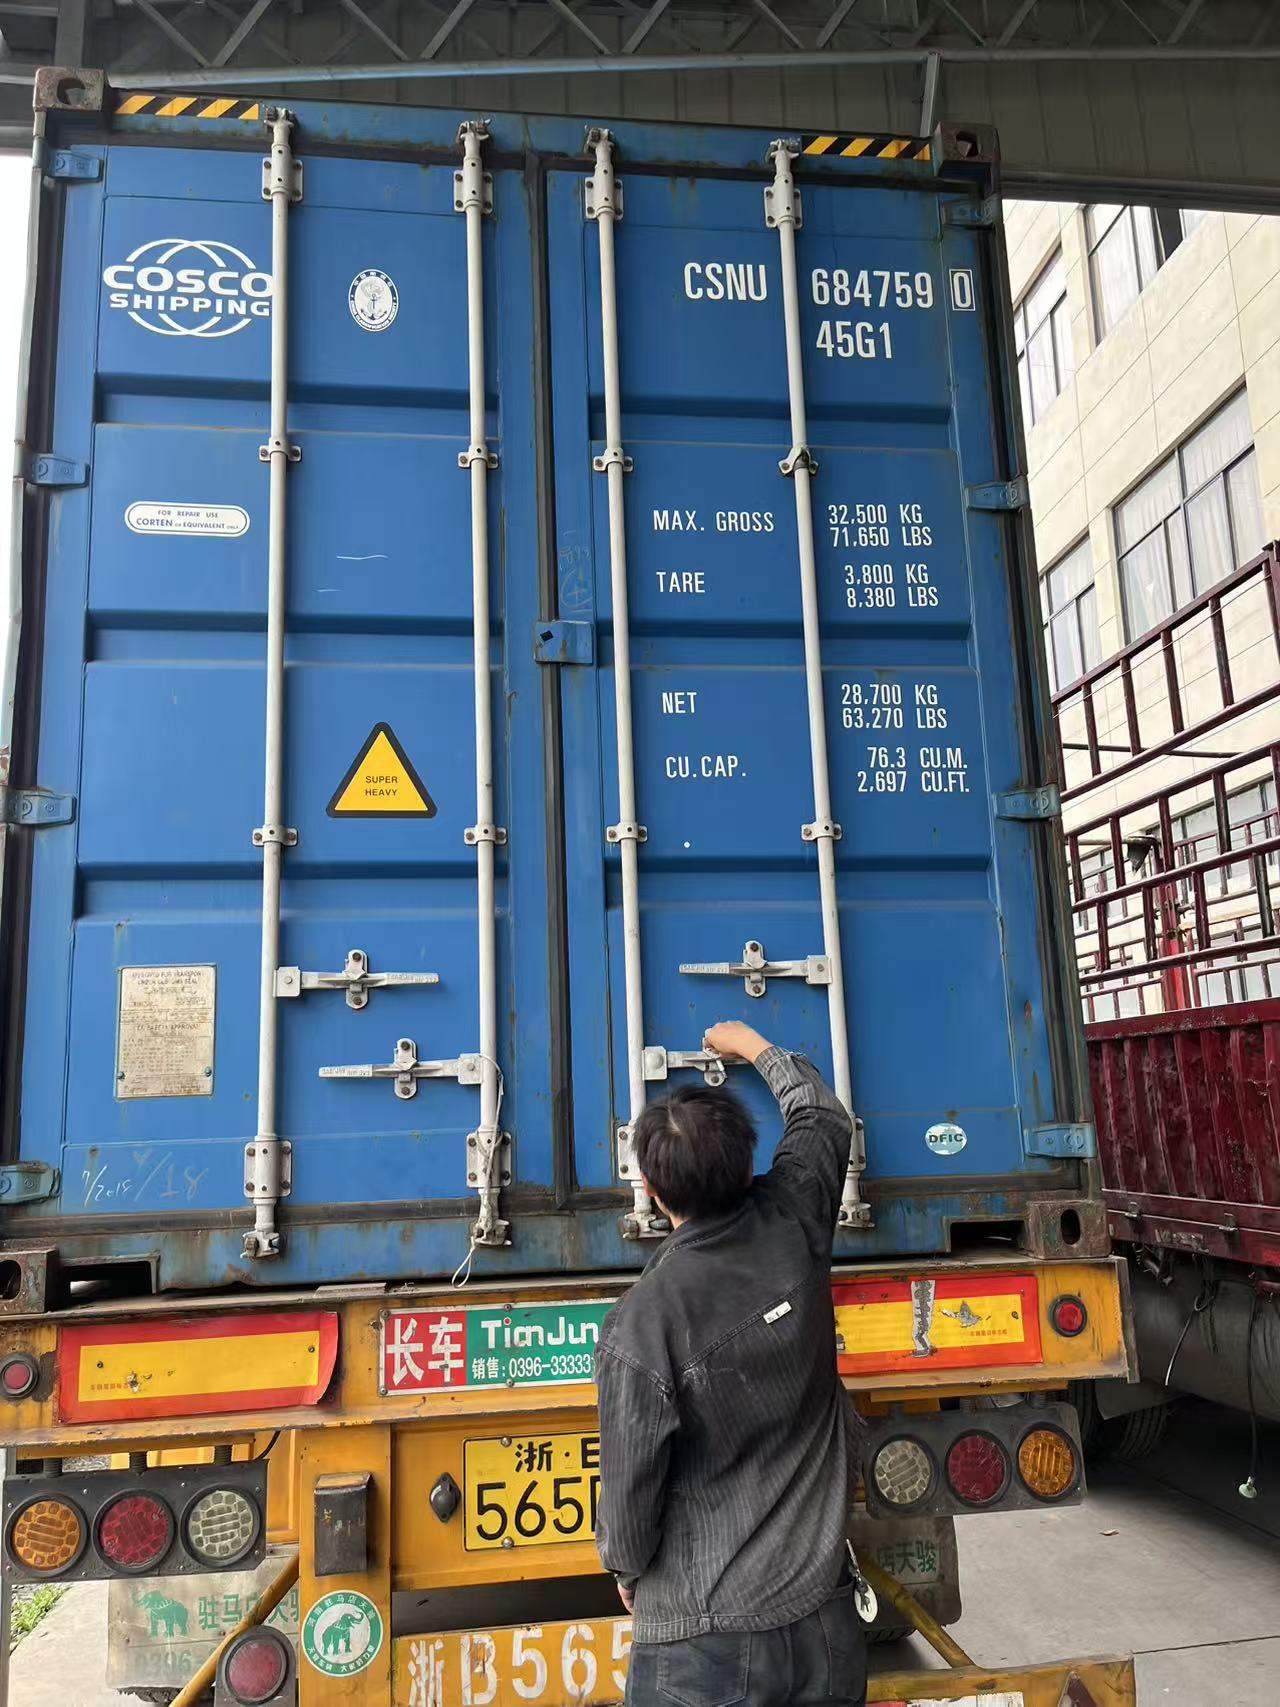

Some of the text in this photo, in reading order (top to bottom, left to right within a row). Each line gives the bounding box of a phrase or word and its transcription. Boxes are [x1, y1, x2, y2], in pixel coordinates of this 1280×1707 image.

[103, 265, 273, 298] COSCO
[684, 262, 972, 308] CSNU 684759 0
[109, 293, 270, 316] SHIPPING
[816, 320, 892, 359] 45G1
[136, 517, 173, 527] CORTEN
[183, 521, 225, 529] EQUIVALENT
[177, 510, 201, 518] REPAIR
[653, 510, 775, 532] MAX. GROSS
[900, 504, 922, 524] KG
[902, 526, 932, 546] LBS
[656, 572, 705, 593] TARE
[905, 564, 929, 584] KG
[908, 587, 939, 607] LBS
[662, 692, 697, 713] NET
[915, 684, 938, 705] KG
[916, 708, 947, 729] LBS
[666, 755, 747, 778] CU.CAP.
[867, 747, 967, 769] 76.3 CU.M.
[365, 776, 398, 784] SUPER
[921, 772, 970, 792] CU.FT.
[365, 788, 398, 796] HEAVY
[928, 1133, 964, 1143] DFIC
[481, 1315, 599, 1349] TianJun
[386, 1317, 464, 1386] 长车
